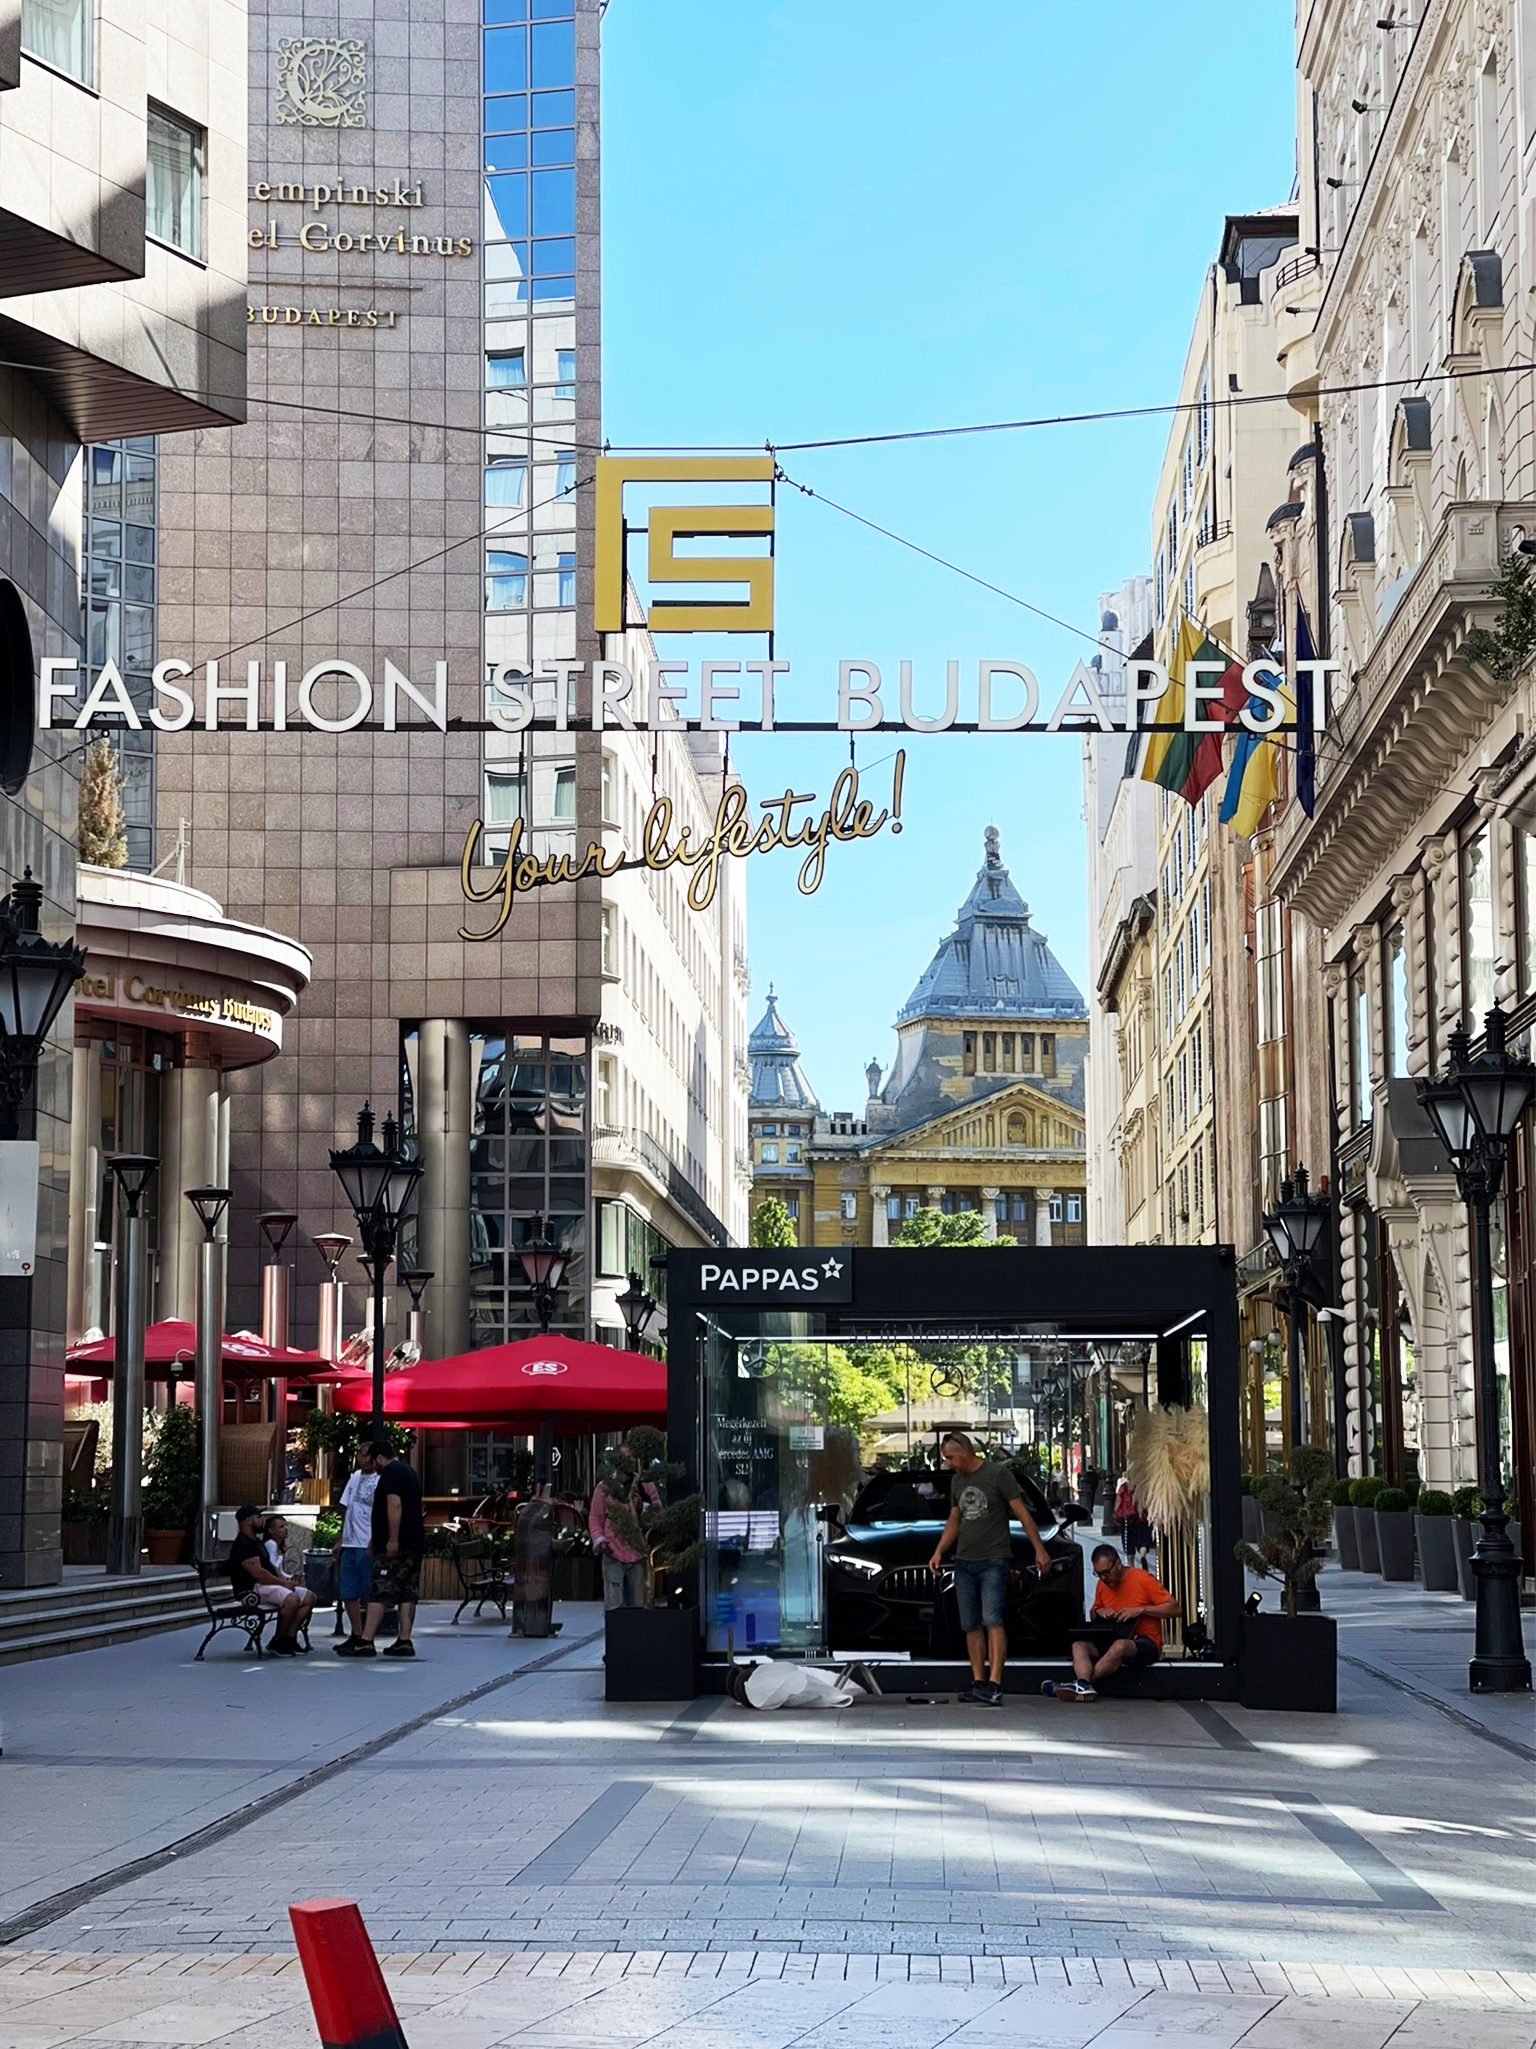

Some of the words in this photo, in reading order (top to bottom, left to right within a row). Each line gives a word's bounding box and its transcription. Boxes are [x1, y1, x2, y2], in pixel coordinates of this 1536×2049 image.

[254, 176, 424, 211] empinski
[299, 222, 472, 256] Corvinus
[39, 657, 449, 732] FASHION
[490, 660, 790, 732] STREET
[838, 660, 1340, 732] BUDAPEST
[458, 817, 625, 942] Your
[643, 748, 906, 912] lifestyle!
[123, 976, 219, 1013] Corvinus
[700, 1264, 819, 1291] PAPPAS
[753, 1448, 774, 1460] AMG
